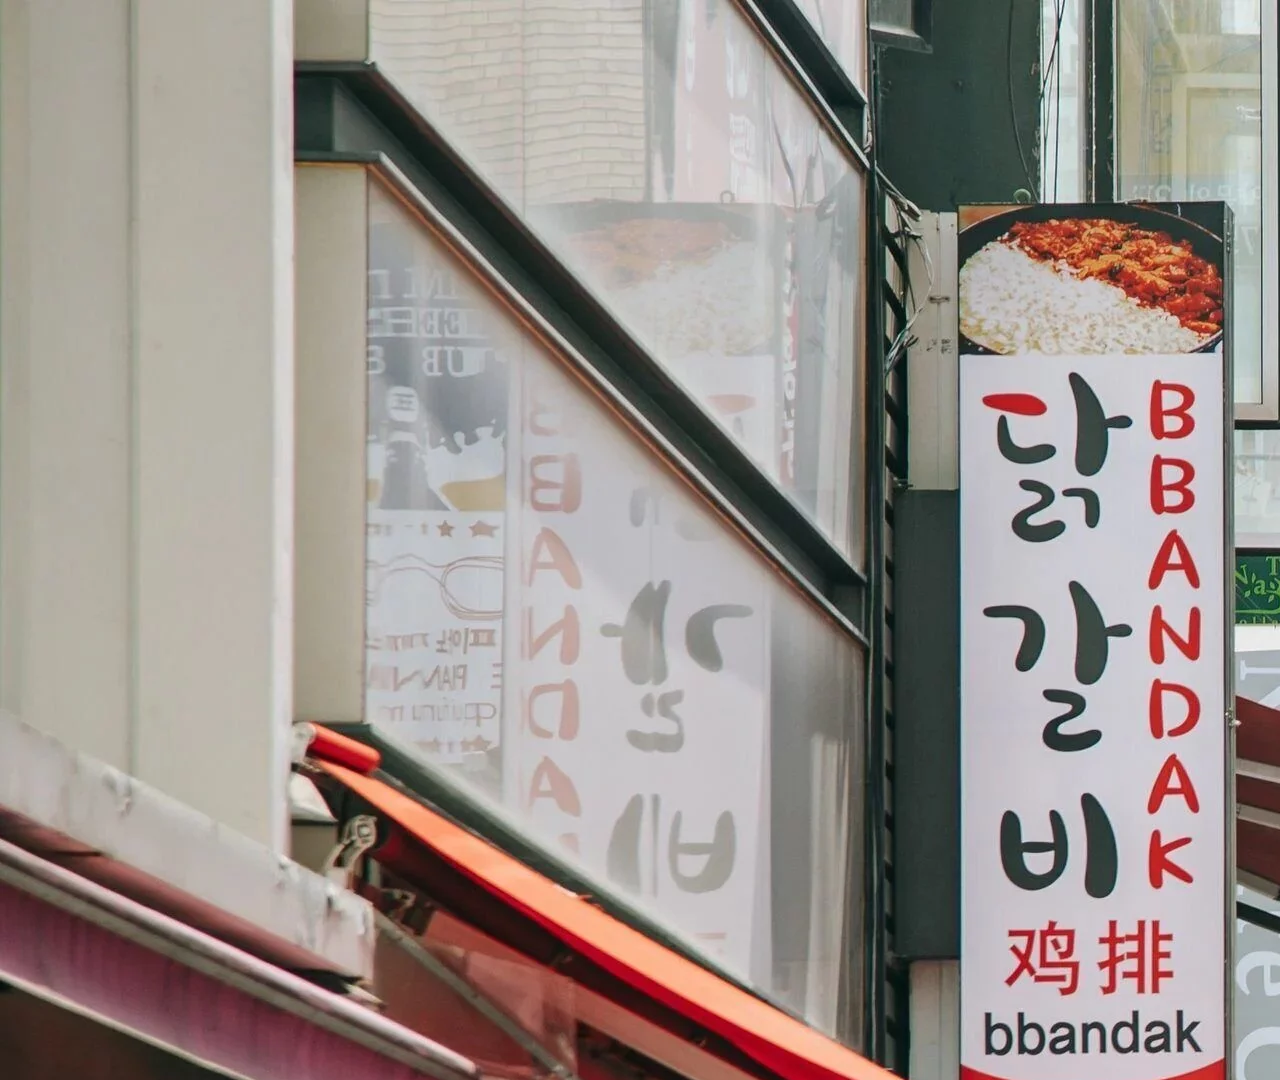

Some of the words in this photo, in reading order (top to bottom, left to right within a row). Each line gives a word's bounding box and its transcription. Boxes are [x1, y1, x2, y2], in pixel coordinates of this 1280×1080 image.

[982, 371, 1133, 899] 닭갈비
[1148, 379, 1202, 890] BBANDAK
[983, 1009, 1203, 1057] bbandak
[1004, 918, 1175, 997] 鸡排
